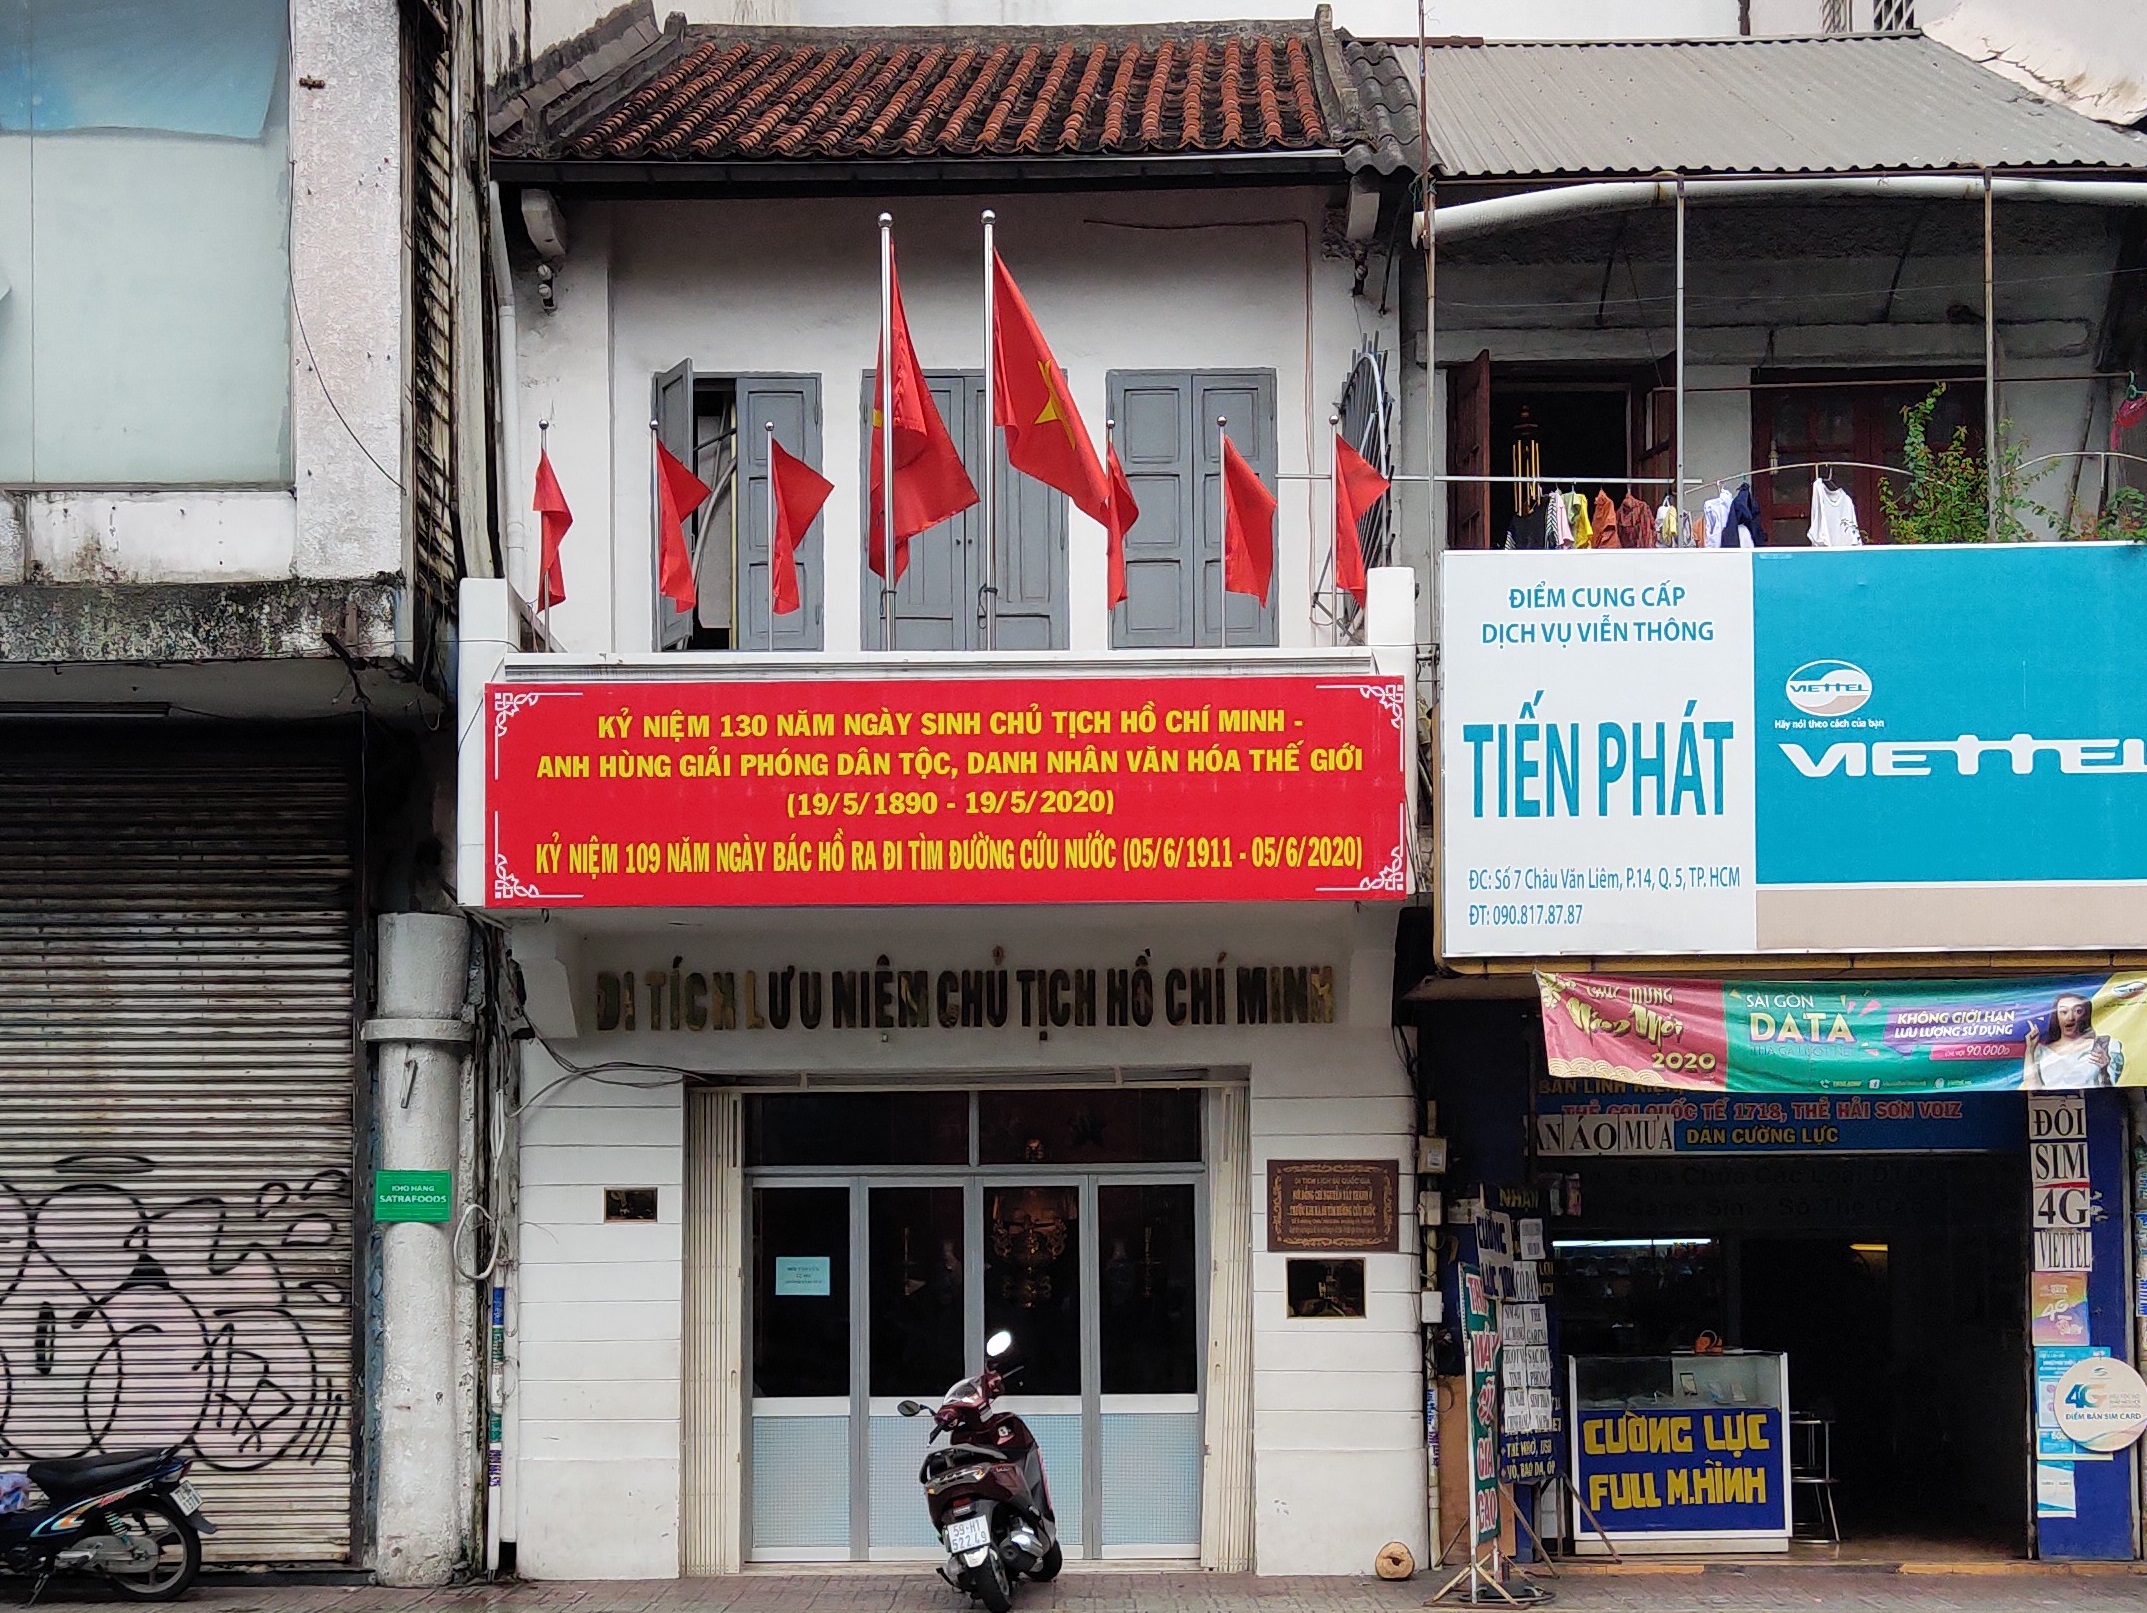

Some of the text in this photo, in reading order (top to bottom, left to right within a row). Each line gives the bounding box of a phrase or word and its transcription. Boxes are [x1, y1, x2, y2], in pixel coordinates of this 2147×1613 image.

[1509, 580, 1686, 609] ĐIỂM CUNG CẤP
[1482, 614, 1714, 649] DỊCH VỤ VIỄN THÔNG
[1789, 682, 1869, 693] VIETTEL
[598, 707, 632, 738] KỶ
[643, 713, 710, 742] NIỆM
[720, 714, 767, 737] 130
[777, 710, 834, 737] NĂM
[844, 707, 910, 737] NGÀY
[921, 711, 981, 735] SINH
[990, 703, 1042, 734] CHỦ
[1052, 710, 1111, 739] TỊCH
[1120, 701, 1156, 733] HỒ
[1166, 704, 1209, 732] CHÍ
[1218, 709, 1285, 732] MINH
[536, 739, 1363, 780] ANH HÙNG GIẢI PHÓNG DÂN TỘC, DANH NHÂN VĂN HÓA THẾ GIỚI
[1463, 690, 1734, 818] TIẾN PHÁT
[788, 792, 938, 818] (19/5/1890
[965, 790, 1115, 816] 19/5/2020)
[536, 832, 563, 875] KỶ
[569, 837, 618, 880] NIỆM
[625, 844, 659, 874] 109
[667, 837, 710, 873] NĂM
[716, 834, 766, 873] NGÀY
[773, 832, 812, 872] BÁC
[818, 828, 845, 872] HỒ
[851, 841, 877, 871] RA
[883, 841, 902, 871] ĐI
[908, 833, 943, 871] TÌM
[949, 831, 1014, 871] ĐƯỜNG
[1020, 831, 1059, 869] CỨU
[1065, 830, 1116, 869] NƯỚC
[1123, 836, 1232, 871] (05/6/1911
[1252, 835, 1363, 870] 05/6/2020)
[1469, 869, 1491, 890] ĐC:
[1495, 866, 1511, 890] Số
[1514, 870, 1521, 889] 7
[1525, 868, 1557, 889] Châu
[1560, 868, 1584, 889] Văn
[1589, 867, 1622, 891] Liêm,
[1627, 867, 1655, 891] P.14,
[1690, 867, 1706, 888] TP.
[1710, 866, 1740, 887] HCM
[1469, 904, 1583, 926] ĐT: 090.817.87.87
[597, 971, 636, 1031] DI
[645, 955, 736, 1031] TÍCH
[746, 965, 822, 1030] LƯU
[937, 945, 1007, 1028] CHỦ
[1016, 969, 1096, 1041] TỊCH
[1107, 948, 1153, 1028] HỒ
[1165, 951, 1227, 1026] CHÍ
[1237, 966, 1334, 1025] MINH
[1750, 1012, 1857, 1043] DATA
[1897, 1009, 2015, 1024] KHÔNG GIỚI HẠN
[1652, 1052, 1716, 1071] 2020
[1734, 1102, 1787, 1122] 1718,
[2033, 1100, 2085, 1137] ĐỔI
[1569, 1114, 1673, 1151] ÁO MƯA
[1687, 1125, 1838, 1146] DÁN CƯỜNG LỰC
[2035, 1143, 2087, 1180] SIM
[380, 1195, 447, 1203] SATRAFOODS
[2038, 1188, 2086, 1225] 4G
[2039, 1232, 2091, 1268] VIETTEL
[2065, 1384, 2108, 1408] 4G
[1582, 1409, 1693, 1455] CƯỜNG
[1704, 1411, 1770, 1458] LỰC
[1589, 1459, 1766, 1511] FULL M.HÌNH
